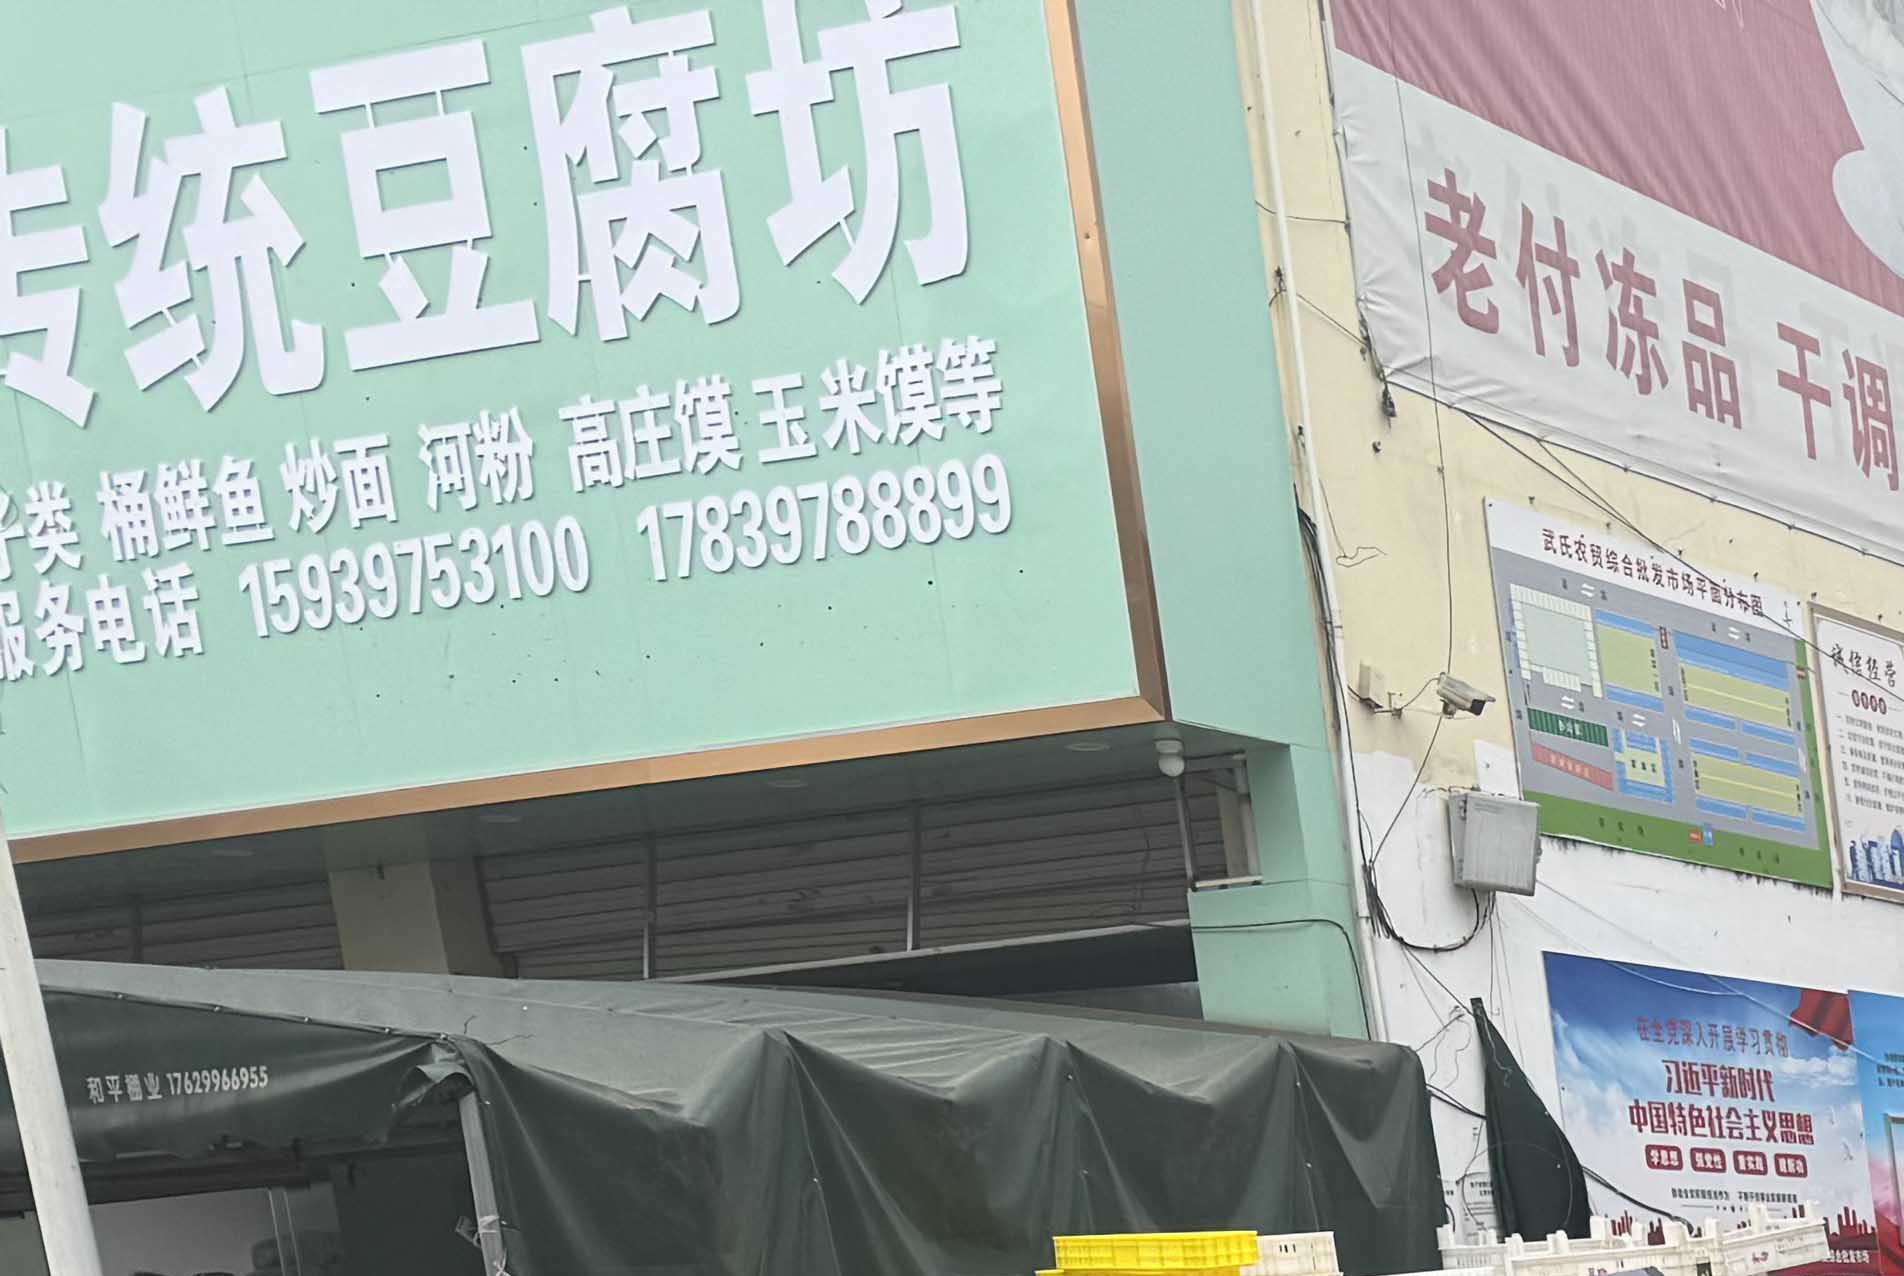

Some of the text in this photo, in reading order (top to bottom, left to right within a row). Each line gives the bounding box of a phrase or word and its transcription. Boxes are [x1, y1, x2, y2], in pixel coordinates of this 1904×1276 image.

[1425, 168, 1900, 491] 老付冻品 干调
[96, 452, 274, 562] 桶鲜鱼
[281, 435, 398, 533] 炒面
[420, 406, 535, 514] 河粉
[559, 376, 745, 492] 高庄馍
[238, 515, 592, 639] 15939753100
[636, 452, 1013, 583] 17839788899
[1542, 527, 1765, 617] 武氏农贸综合批发市场平面分布图
[86, 1065, 269, 1106] 和平棚业 17629966955
[1628, 1099, 1815, 1145] 中国特色社会主义思想
[1661, 1059, 1776, 1103] 习近平新时代
